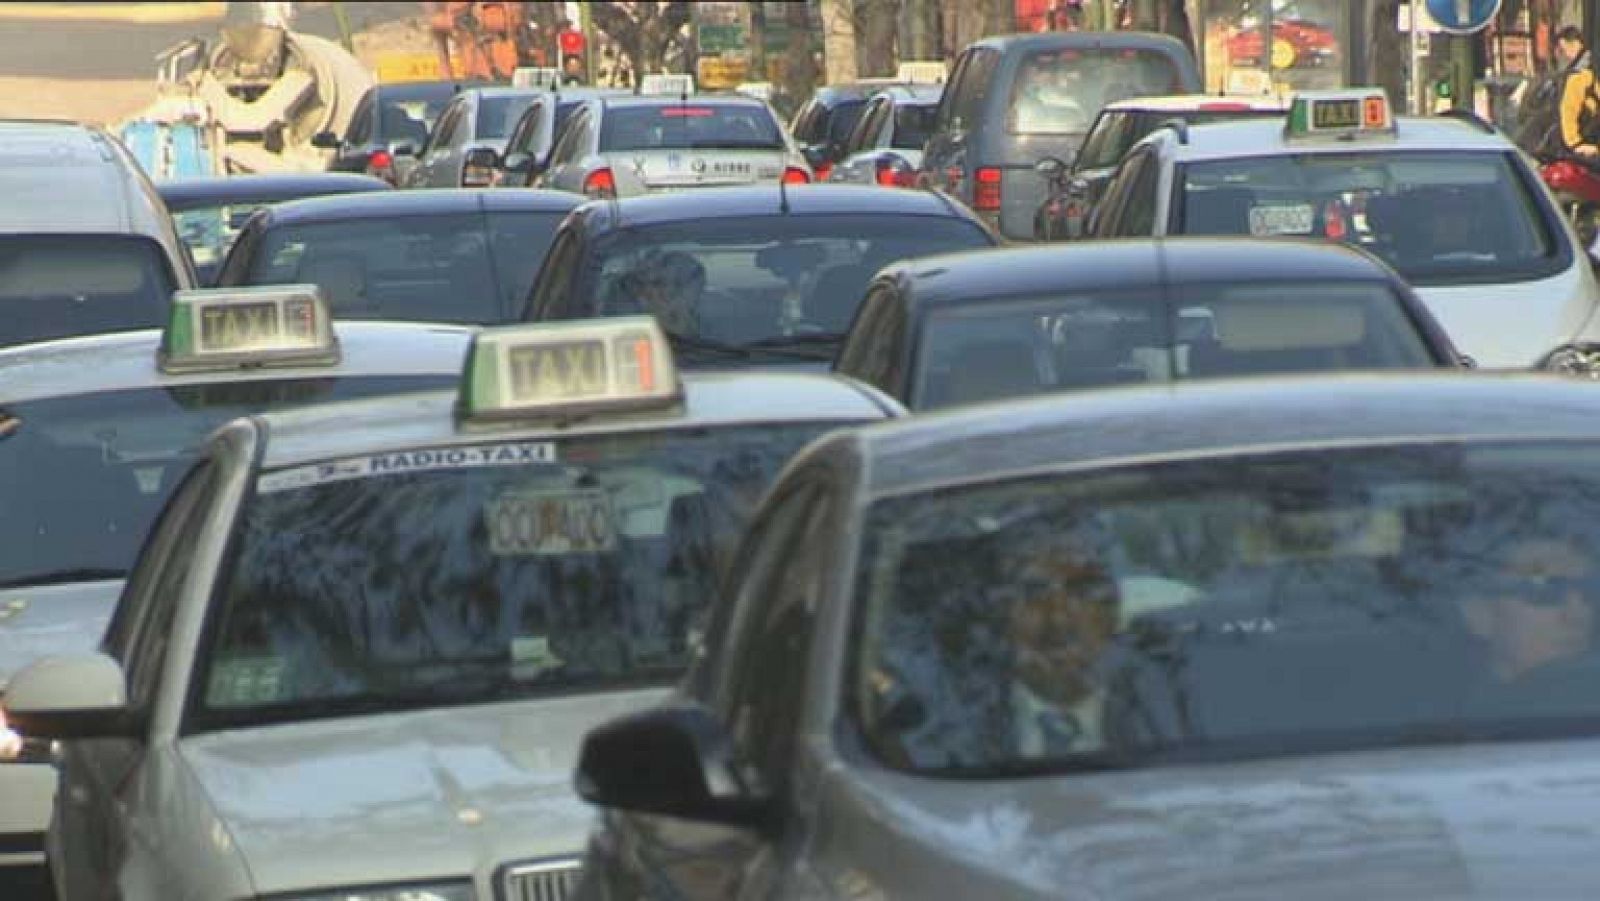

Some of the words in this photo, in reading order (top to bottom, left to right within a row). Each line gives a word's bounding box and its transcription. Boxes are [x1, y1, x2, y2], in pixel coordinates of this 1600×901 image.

[1315, 102, 1358, 126] TAXI
[206, 303, 279, 346] TAXI
[509, 346, 606, 396] TAXI
[368, 445, 546, 472] RADIO-TAXI
